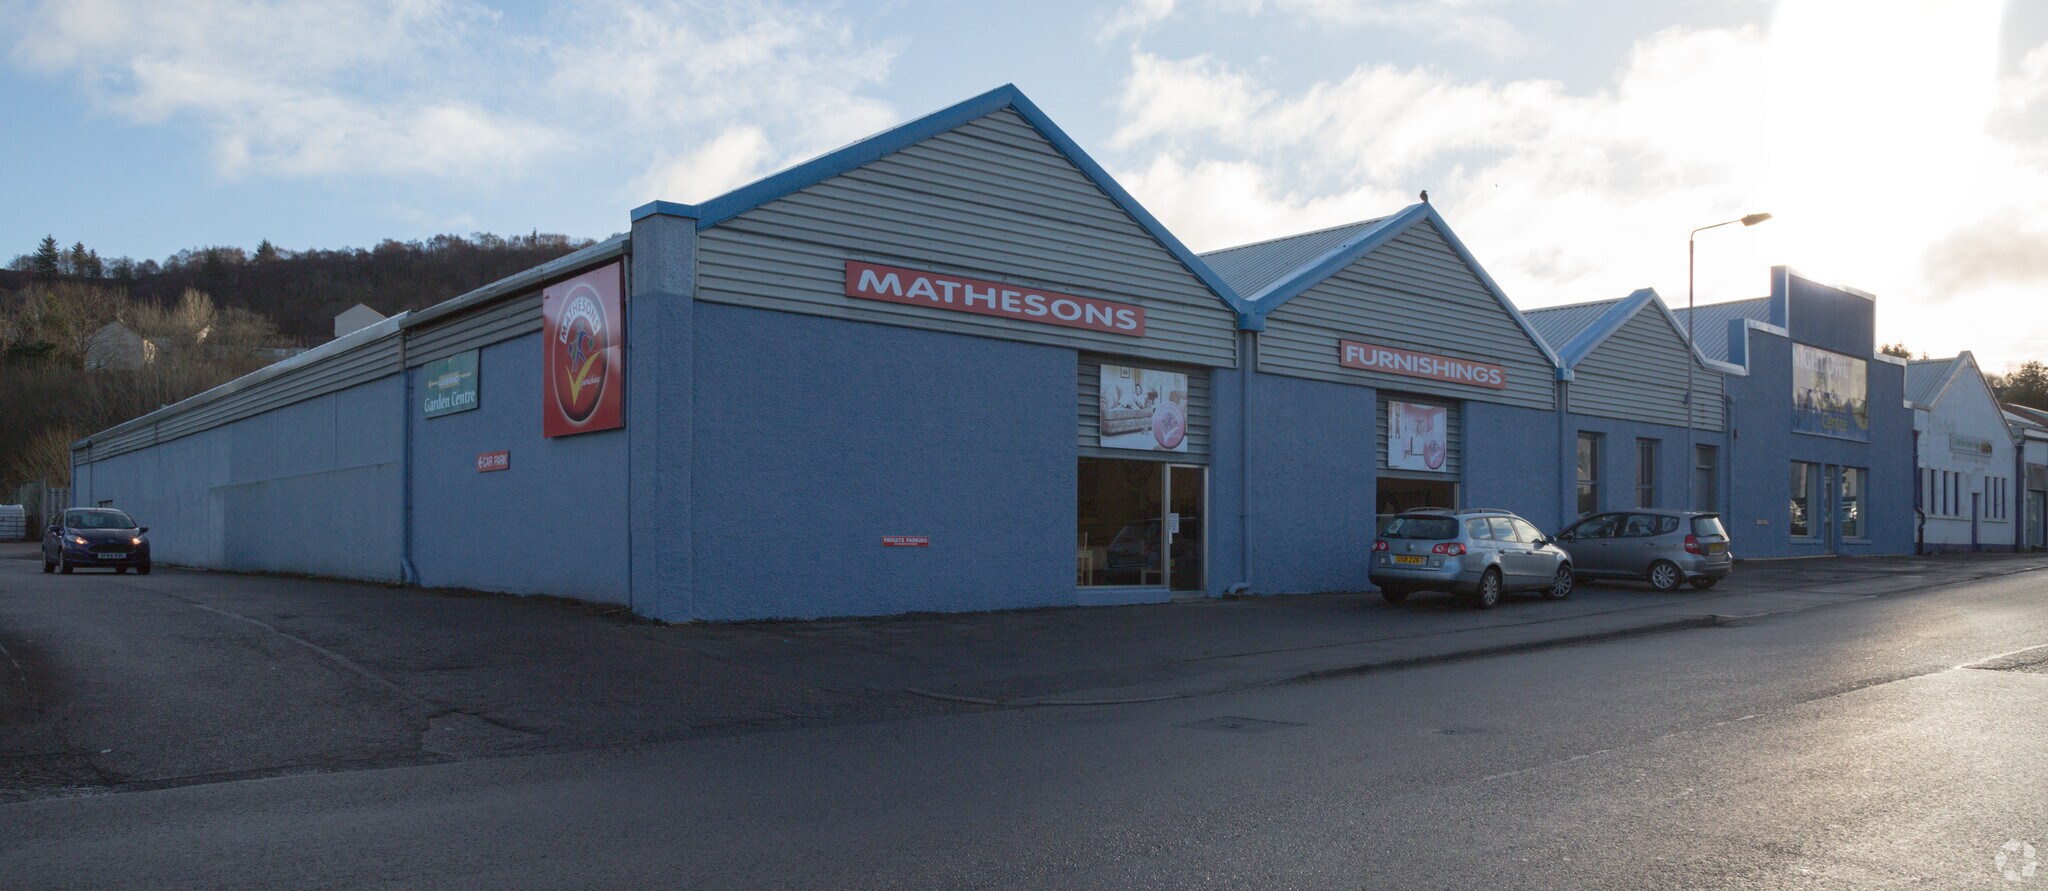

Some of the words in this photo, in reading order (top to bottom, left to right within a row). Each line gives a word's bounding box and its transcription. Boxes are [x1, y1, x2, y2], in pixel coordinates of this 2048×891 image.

[857, 269, 1138, 331] MATHESONS
[561, 298, 600, 341] MATHESONS
[1346, 345, 1502, 385] FURNISHINGS
[1792, 344, 1824, 372] NIGHT
[424, 393, 450, 413] Garden
[451, 389, 476, 407] Centre
[482, 455, 493, 468] CAR
[493, 454, 508, 466] PARK
